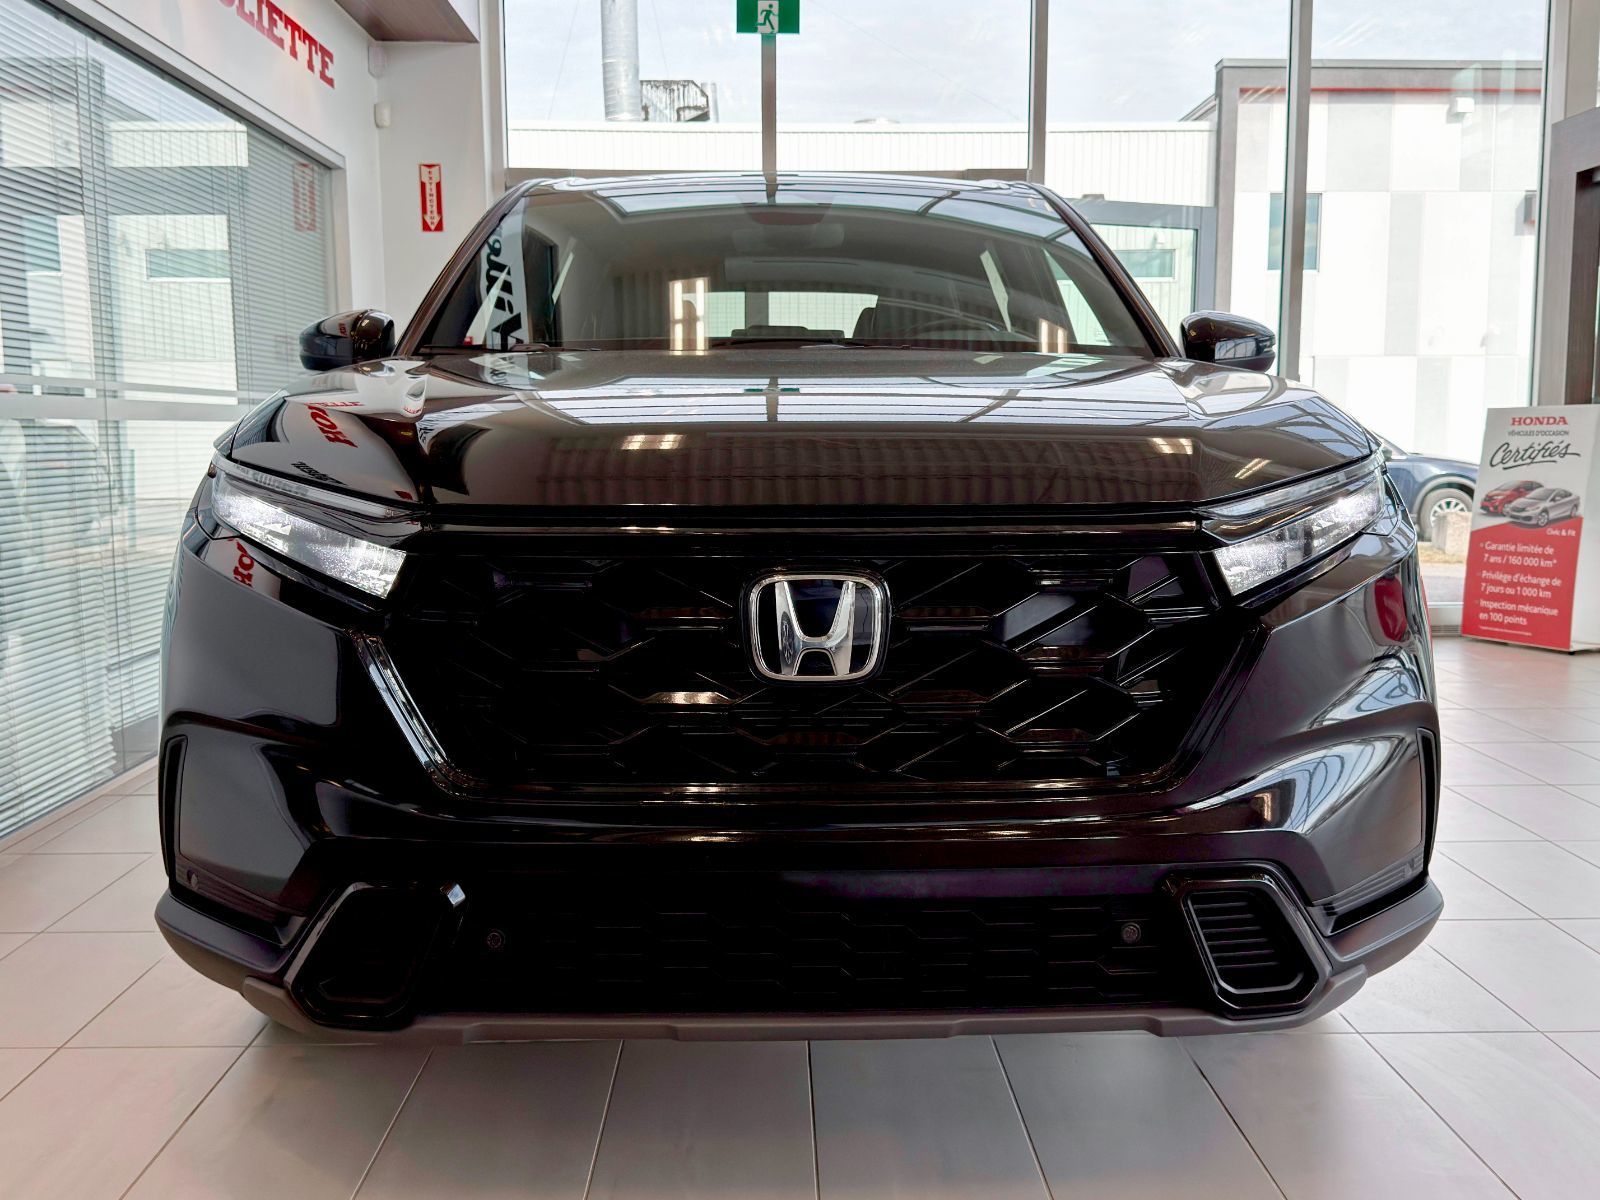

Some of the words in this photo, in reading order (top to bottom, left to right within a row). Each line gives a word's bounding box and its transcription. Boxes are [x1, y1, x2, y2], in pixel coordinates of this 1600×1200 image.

[218, 0, 335, 90] LIETTE
[1511, 416, 1569, 426] HONDA
[1489, 440, 1581, 469] Certifiés
[1485, 541, 1515, 551] Garantie
[1517, 542, 1543, 554] limitée
[1544, 546, 1554, 555] de
[1483, 554, 1488, 562] 7
[1488, 556, 1502, 564] ans
[1508, 556, 1521, 565] 160
[1523, 556, 1539, 566] 000
[1481, 570, 1512, 583] Privilège
[1512, 573, 1550, 587] d'échange
[1552, 576, 1562, 586] de
[1480, 582, 1486, 591] 7
[1486, 584, 1504, 594] jours
[1505, 586, 1515, 594] ou
[1516, 586, 1521, 595] 1
[1522, 587, 1538, 597] 000
[1539, 588, 1552, 598] km
[1480, 599, 1516, 611] Inspection
[1518, 604, 1558, 616] mécanique
[1490, 612, 1502, 622] 100
[1504, 614, 1527, 625] points
